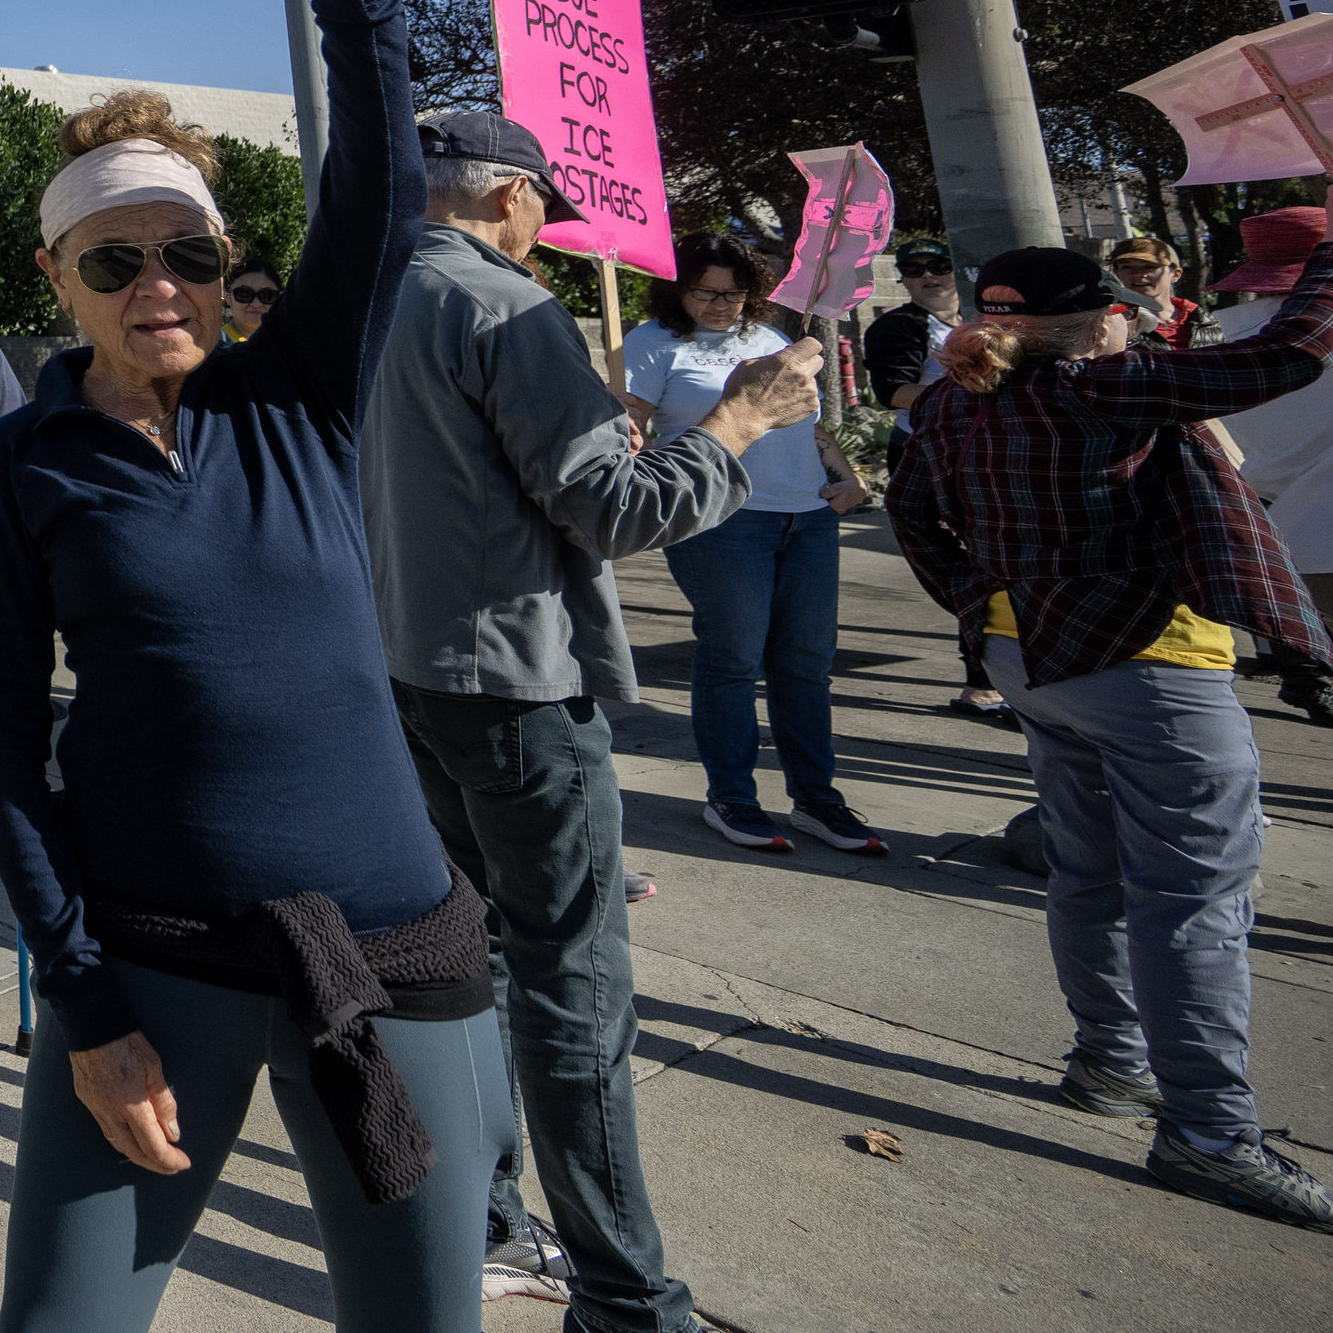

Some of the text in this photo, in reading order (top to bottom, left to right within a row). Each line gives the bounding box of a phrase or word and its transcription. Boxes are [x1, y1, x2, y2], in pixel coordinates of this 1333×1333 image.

[560, 61, 611, 116] FOR
[561, 117, 615, 168] ICE
[550, 161, 647, 226] OSTAGES
[983, 305, 1012, 313] PIXAR
